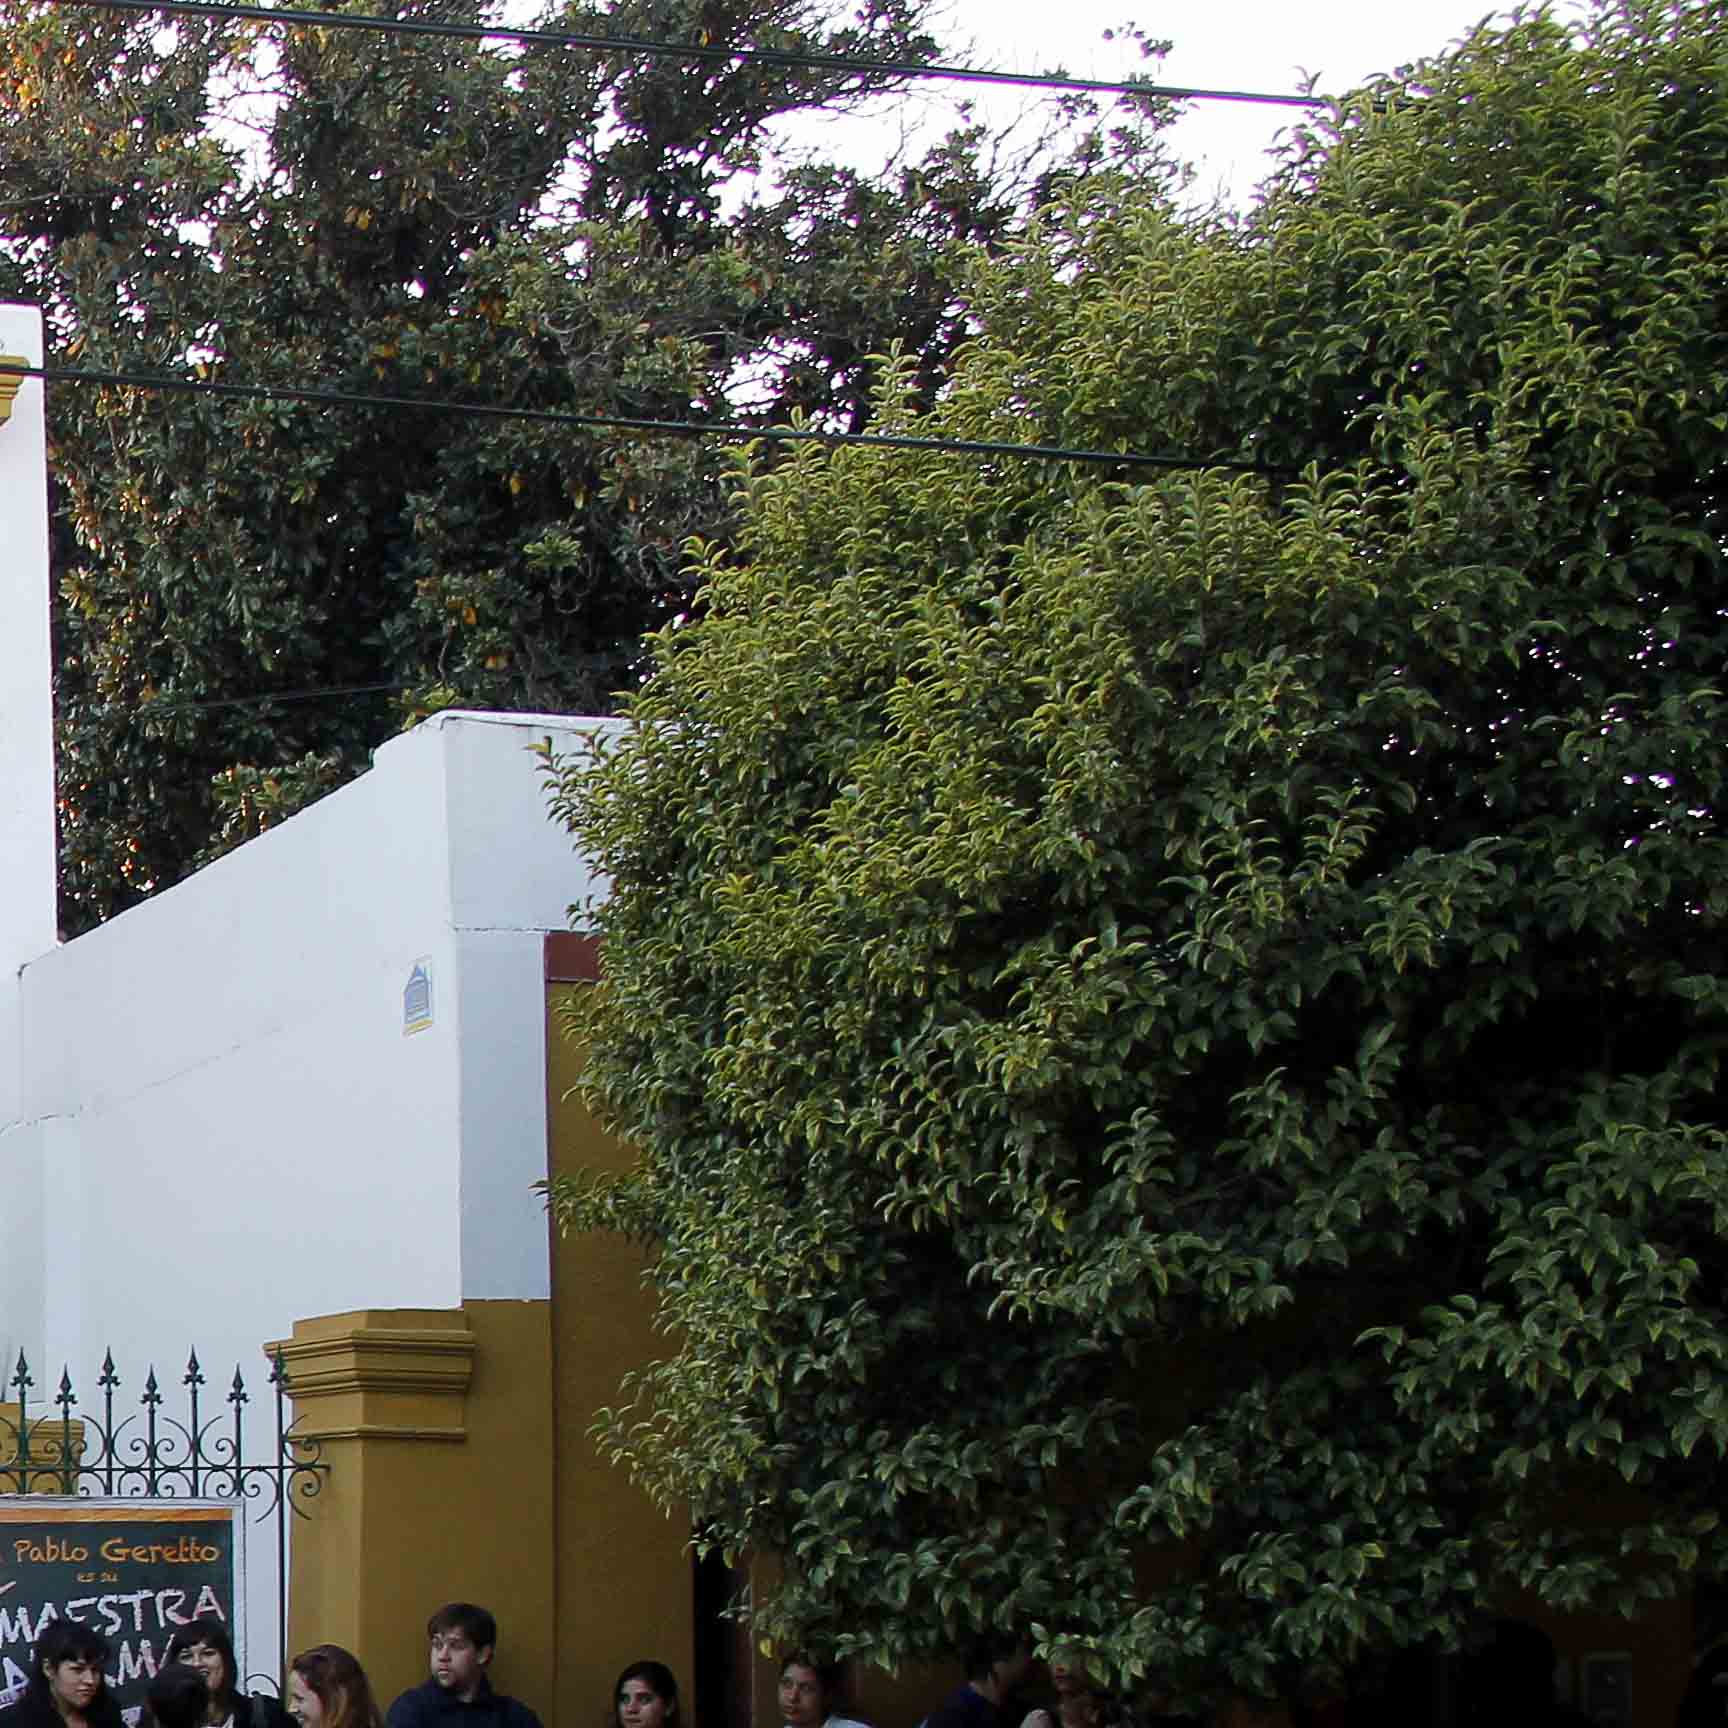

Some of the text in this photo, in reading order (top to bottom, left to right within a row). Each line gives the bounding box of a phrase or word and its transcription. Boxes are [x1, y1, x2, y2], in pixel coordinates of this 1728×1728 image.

[13, 1536, 89, 1563] Pablo
[101, 1536, 222, 1564] Geretto
[76, 1572, 95, 1583] es
